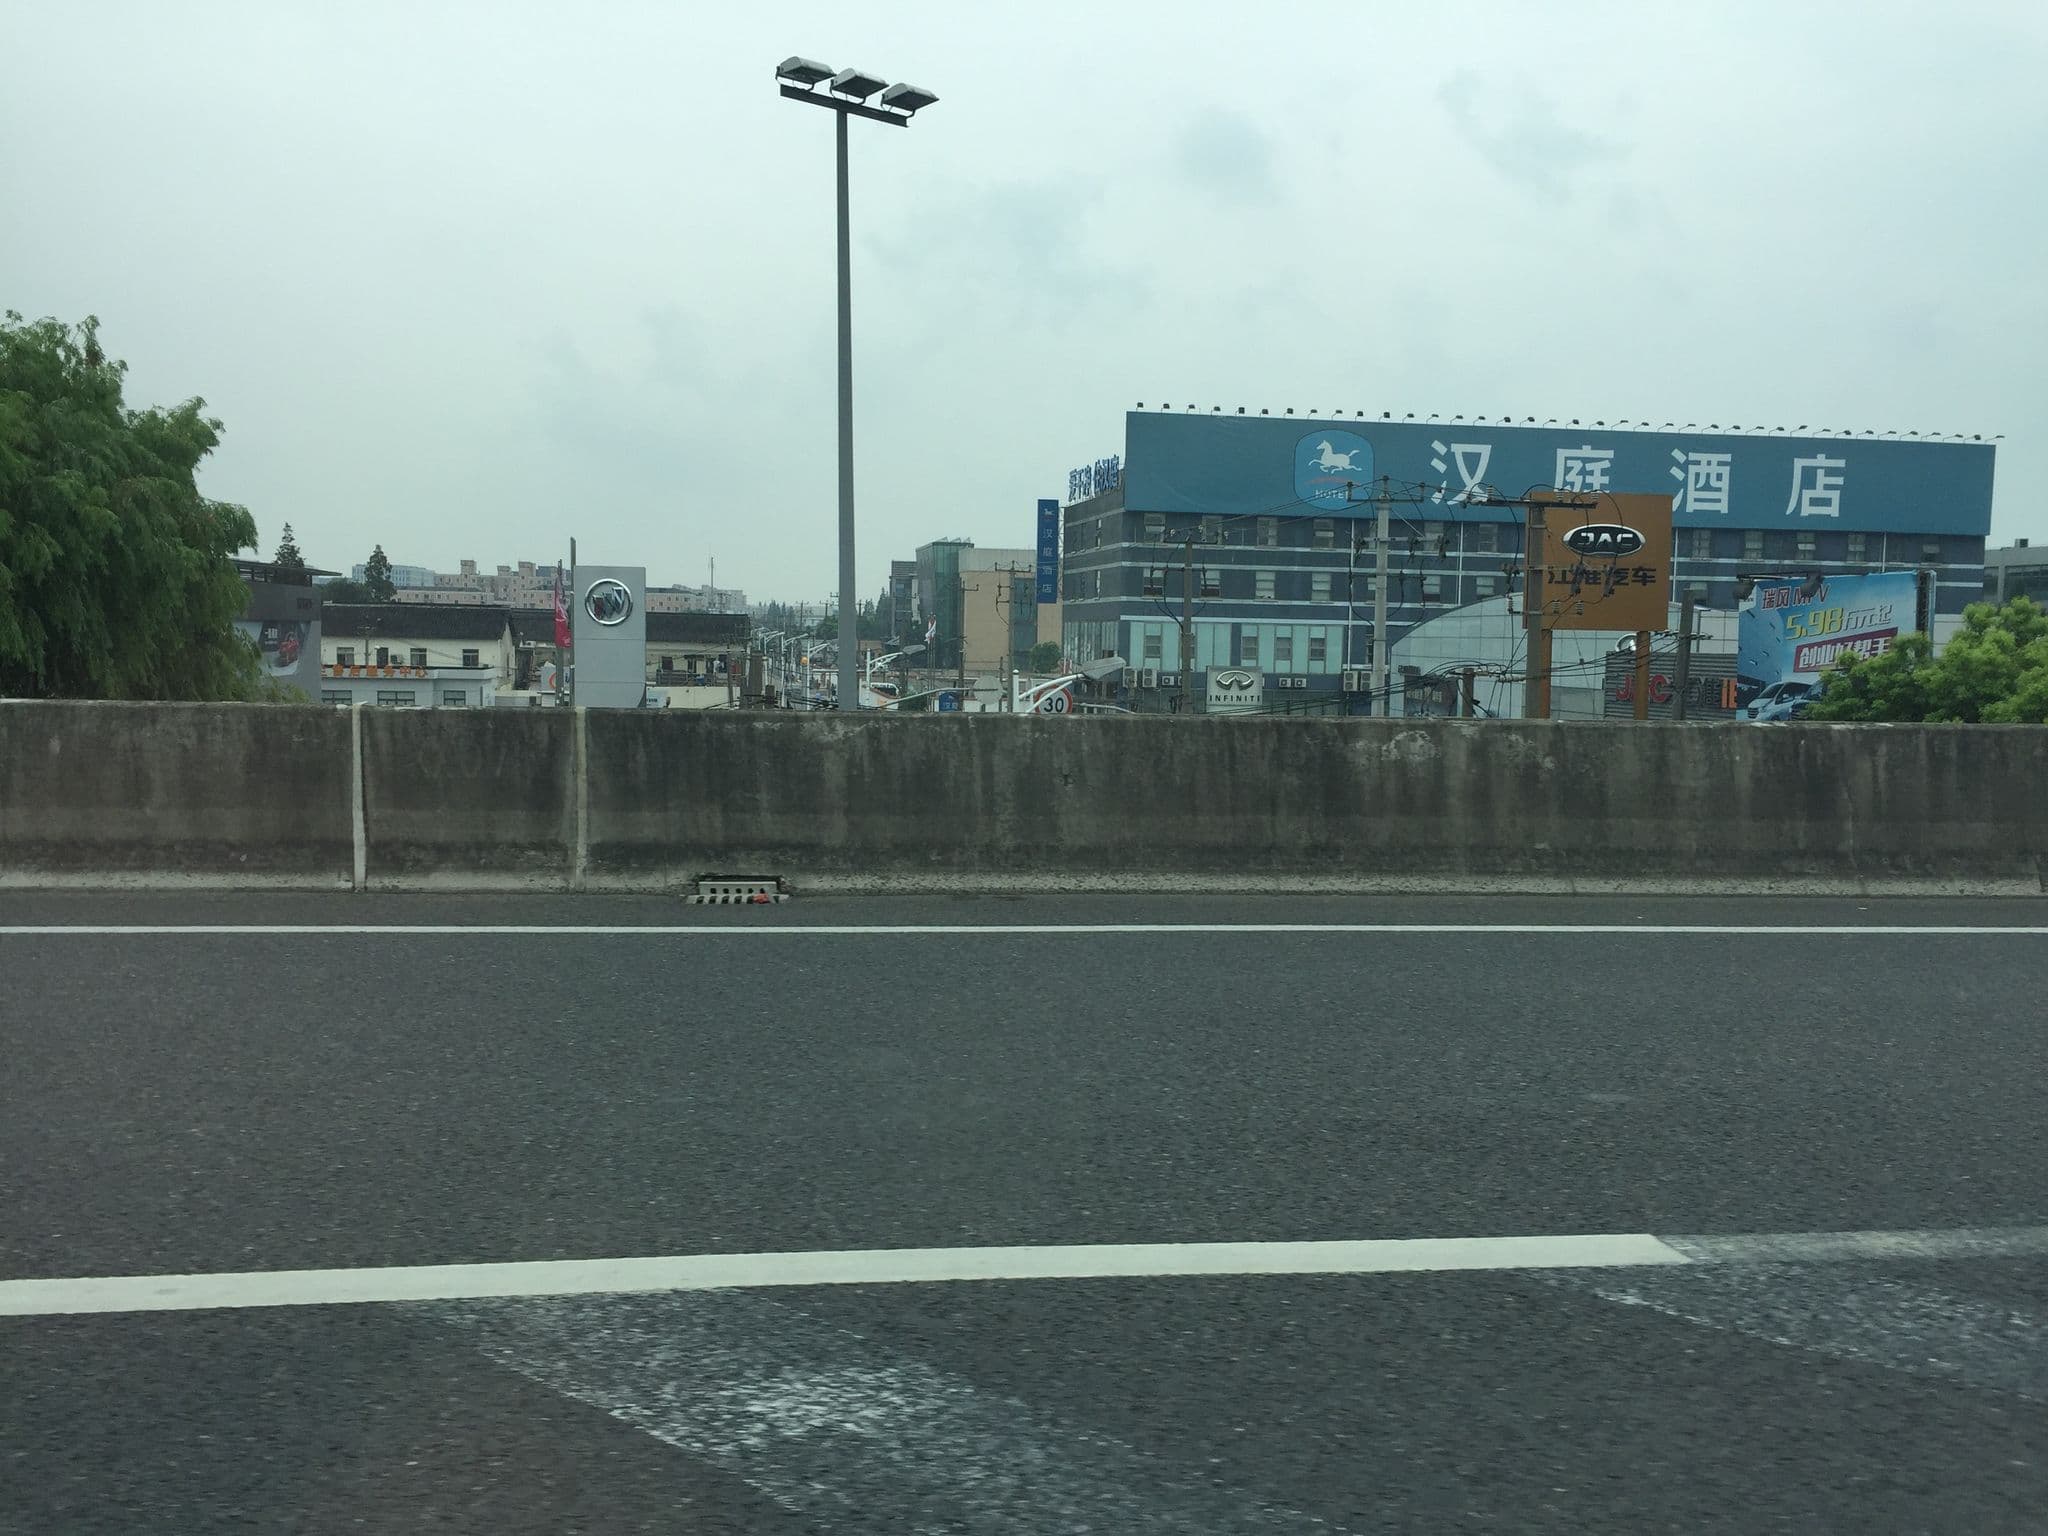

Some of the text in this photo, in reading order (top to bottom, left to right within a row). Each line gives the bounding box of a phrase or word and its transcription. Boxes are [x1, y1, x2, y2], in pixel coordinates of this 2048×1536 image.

[1430, 439, 1847, 518] 汉庭酒店
[1578, 532, 1634, 547] JAC
[1043, 697, 1064, 712] 30
